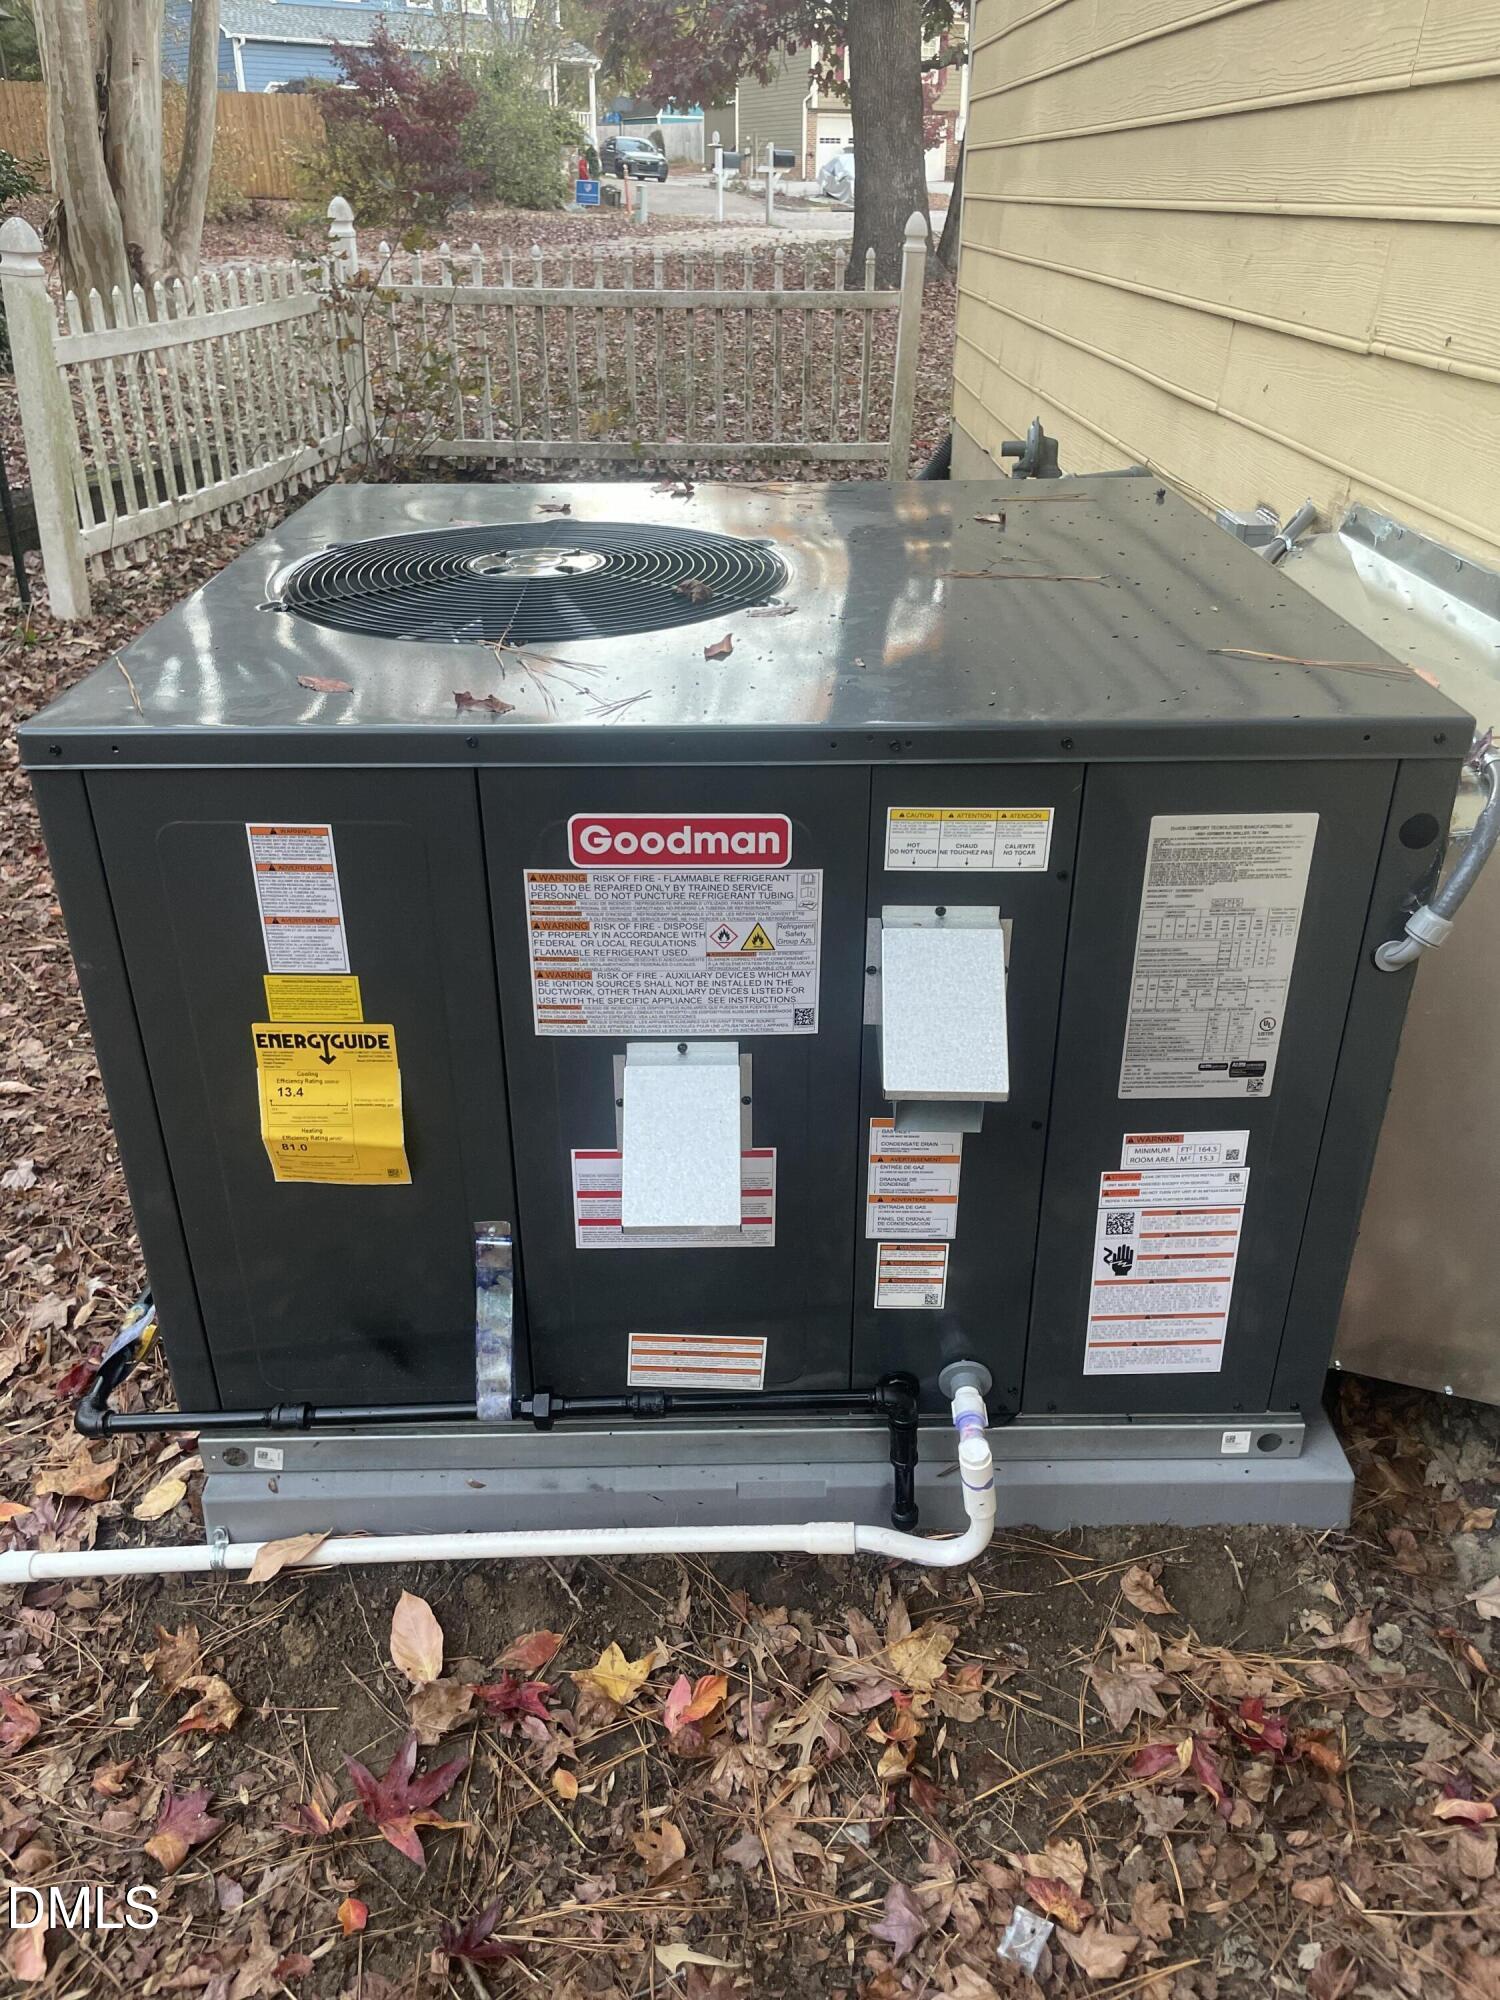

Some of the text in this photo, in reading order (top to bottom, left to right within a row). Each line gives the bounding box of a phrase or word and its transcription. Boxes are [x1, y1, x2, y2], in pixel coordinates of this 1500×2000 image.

[580, 825, 780, 855] Goodman
[785, 930, 806, 938] Safety
[581, 939, 594, 947] OR
[597, 939, 627, 947] LOCAL
[631, 939, 697, 947] REGULATIONS
[545, 971, 591, 979] WARNING
[538, 988, 595, 996] DUCTWORK,
[728, 996, 796, 1004] INSTRUCTIONS
[256, 1034, 390, 1049] ENERGYGUIDE
[278, 1087, 304, 1097] 13.4
[282, 1143, 308, 1151] 81.0
